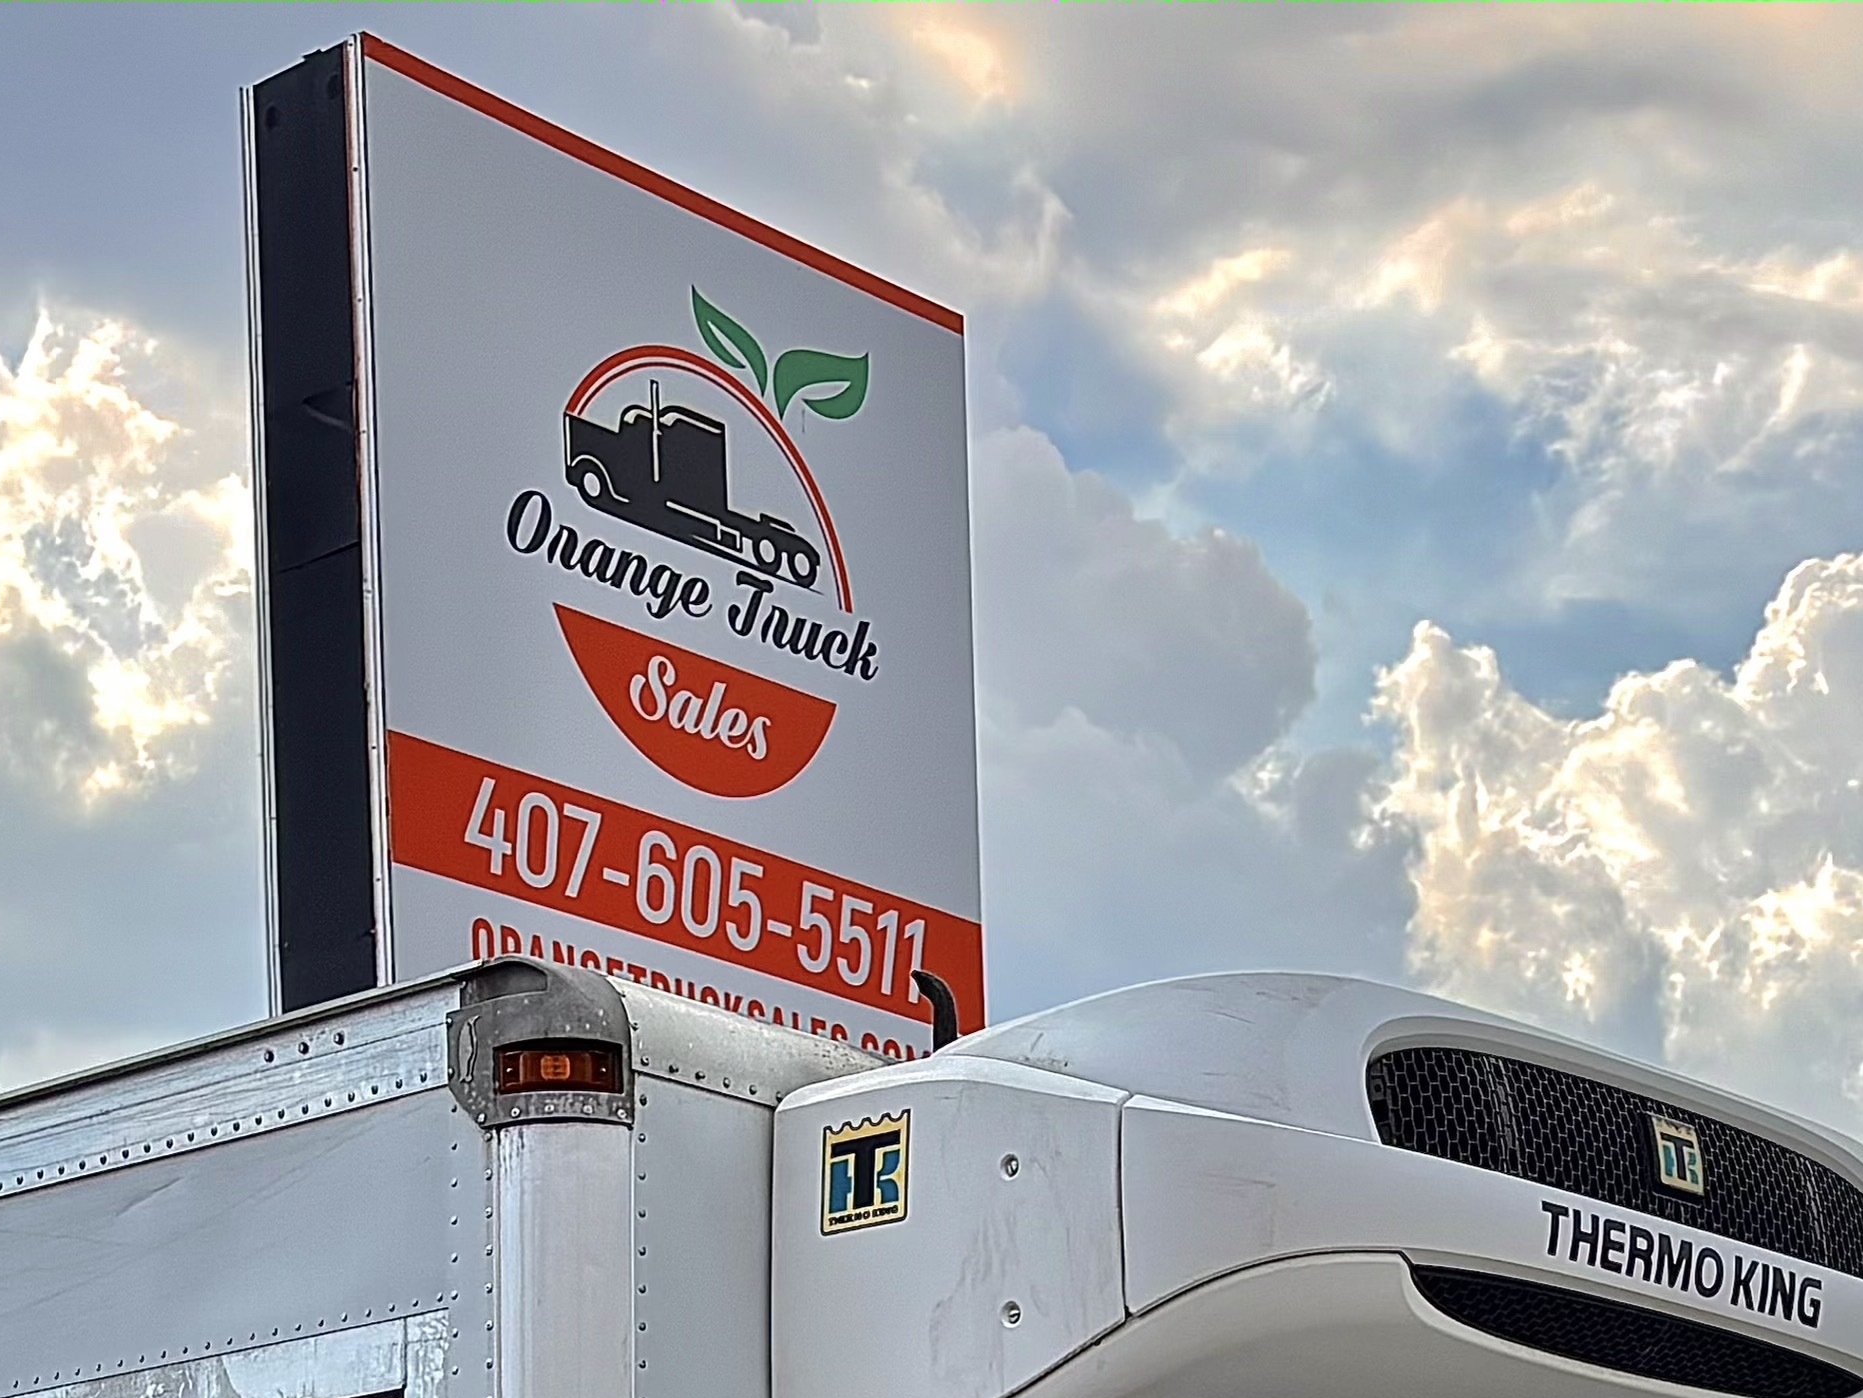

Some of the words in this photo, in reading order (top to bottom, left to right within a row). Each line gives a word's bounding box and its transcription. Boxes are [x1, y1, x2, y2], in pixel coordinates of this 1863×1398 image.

[506, 489, 713, 619] Orange
[727, 570, 879, 681] Truck
[629, 654, 772, 760] Sales
[464, 777, 926, 1004] 407-605-5511
[1541, 1201, 1725, 1299] THERMO
[1730, 1255, 1823, 1329] KING
